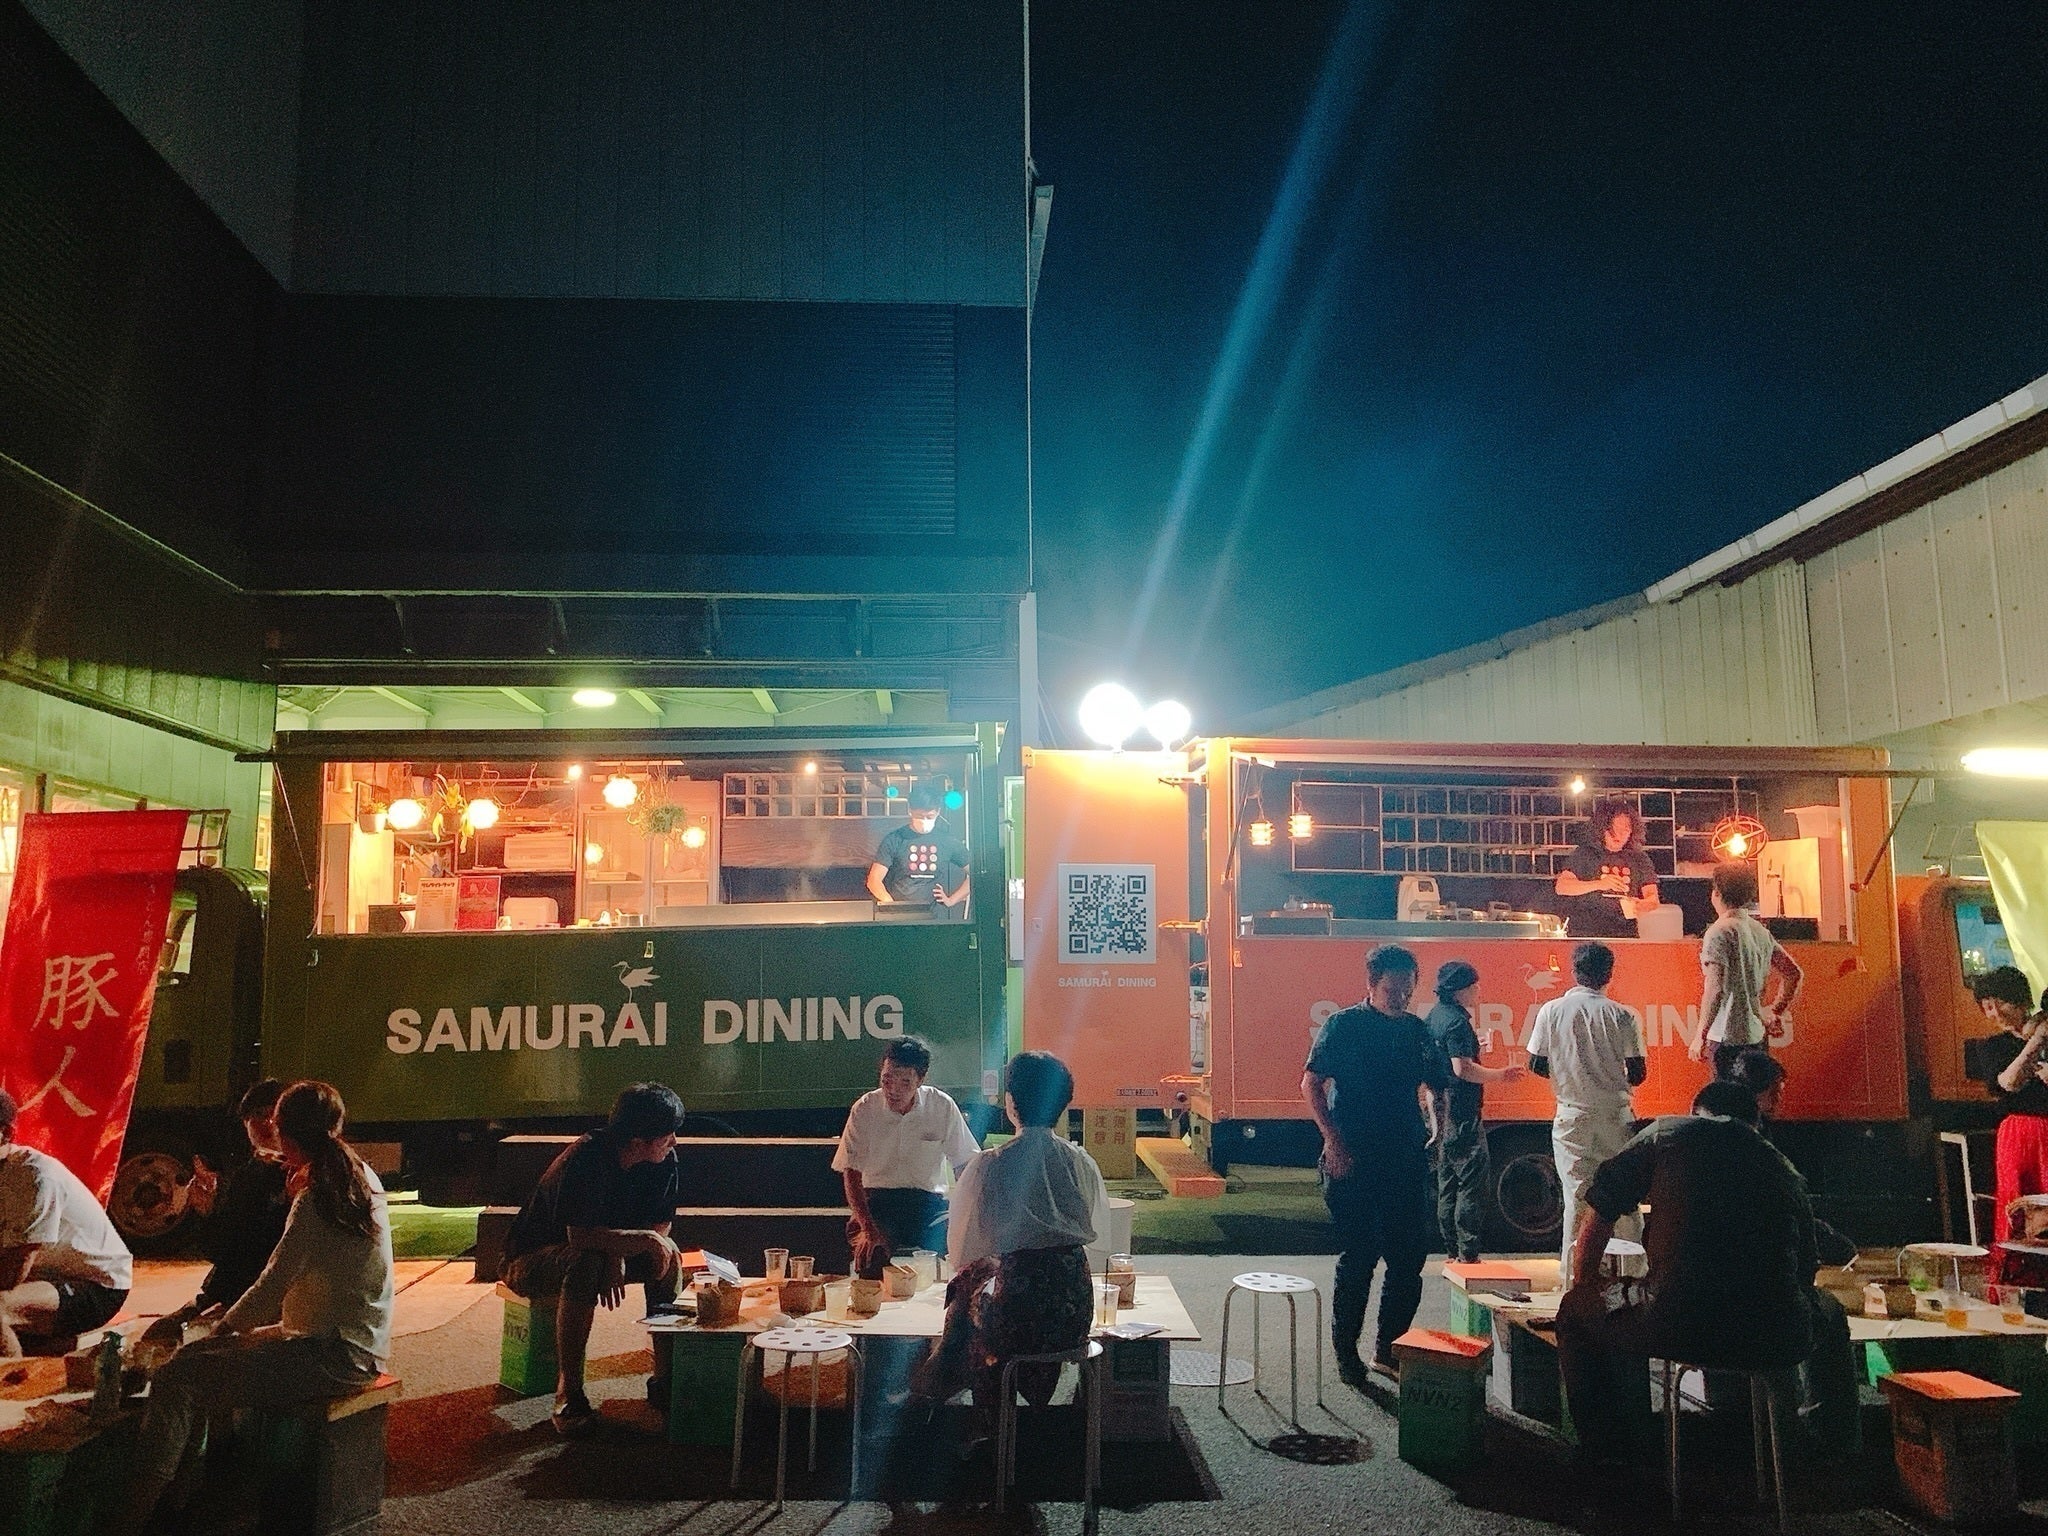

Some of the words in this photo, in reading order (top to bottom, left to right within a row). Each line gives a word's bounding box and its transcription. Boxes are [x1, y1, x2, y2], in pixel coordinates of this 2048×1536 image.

[1058, 977, 1112, 987] SAMURAI
[1117, 977, 1157, 987] DINING
[17, 952, 120, 1118] 豚人
[386, 1001, 668, 1054] SAMURAI
[703, 994, 904, 1045] DINING
